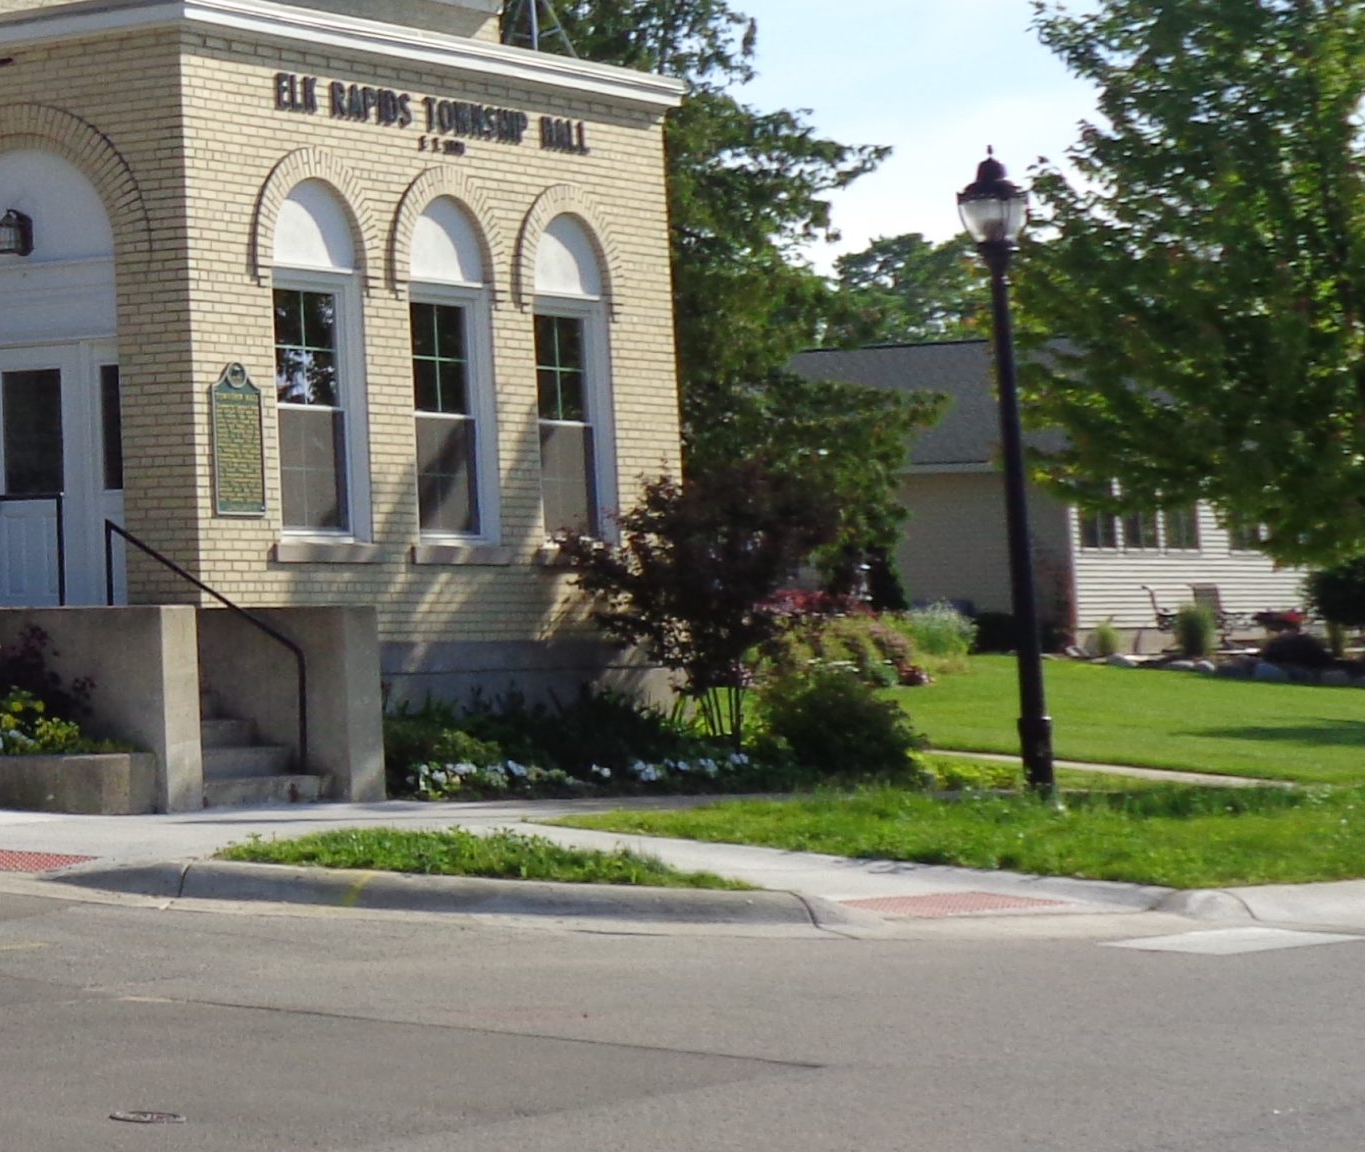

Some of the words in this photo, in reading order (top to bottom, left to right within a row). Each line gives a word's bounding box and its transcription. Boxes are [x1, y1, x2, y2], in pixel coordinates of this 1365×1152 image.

[274, 72, 317, 115] ELK
[329, 81, 412, 129] RAPIDS
[421, 96, 529, 145] TOWNSHIP
[539, 116, 590, 156] HALL
